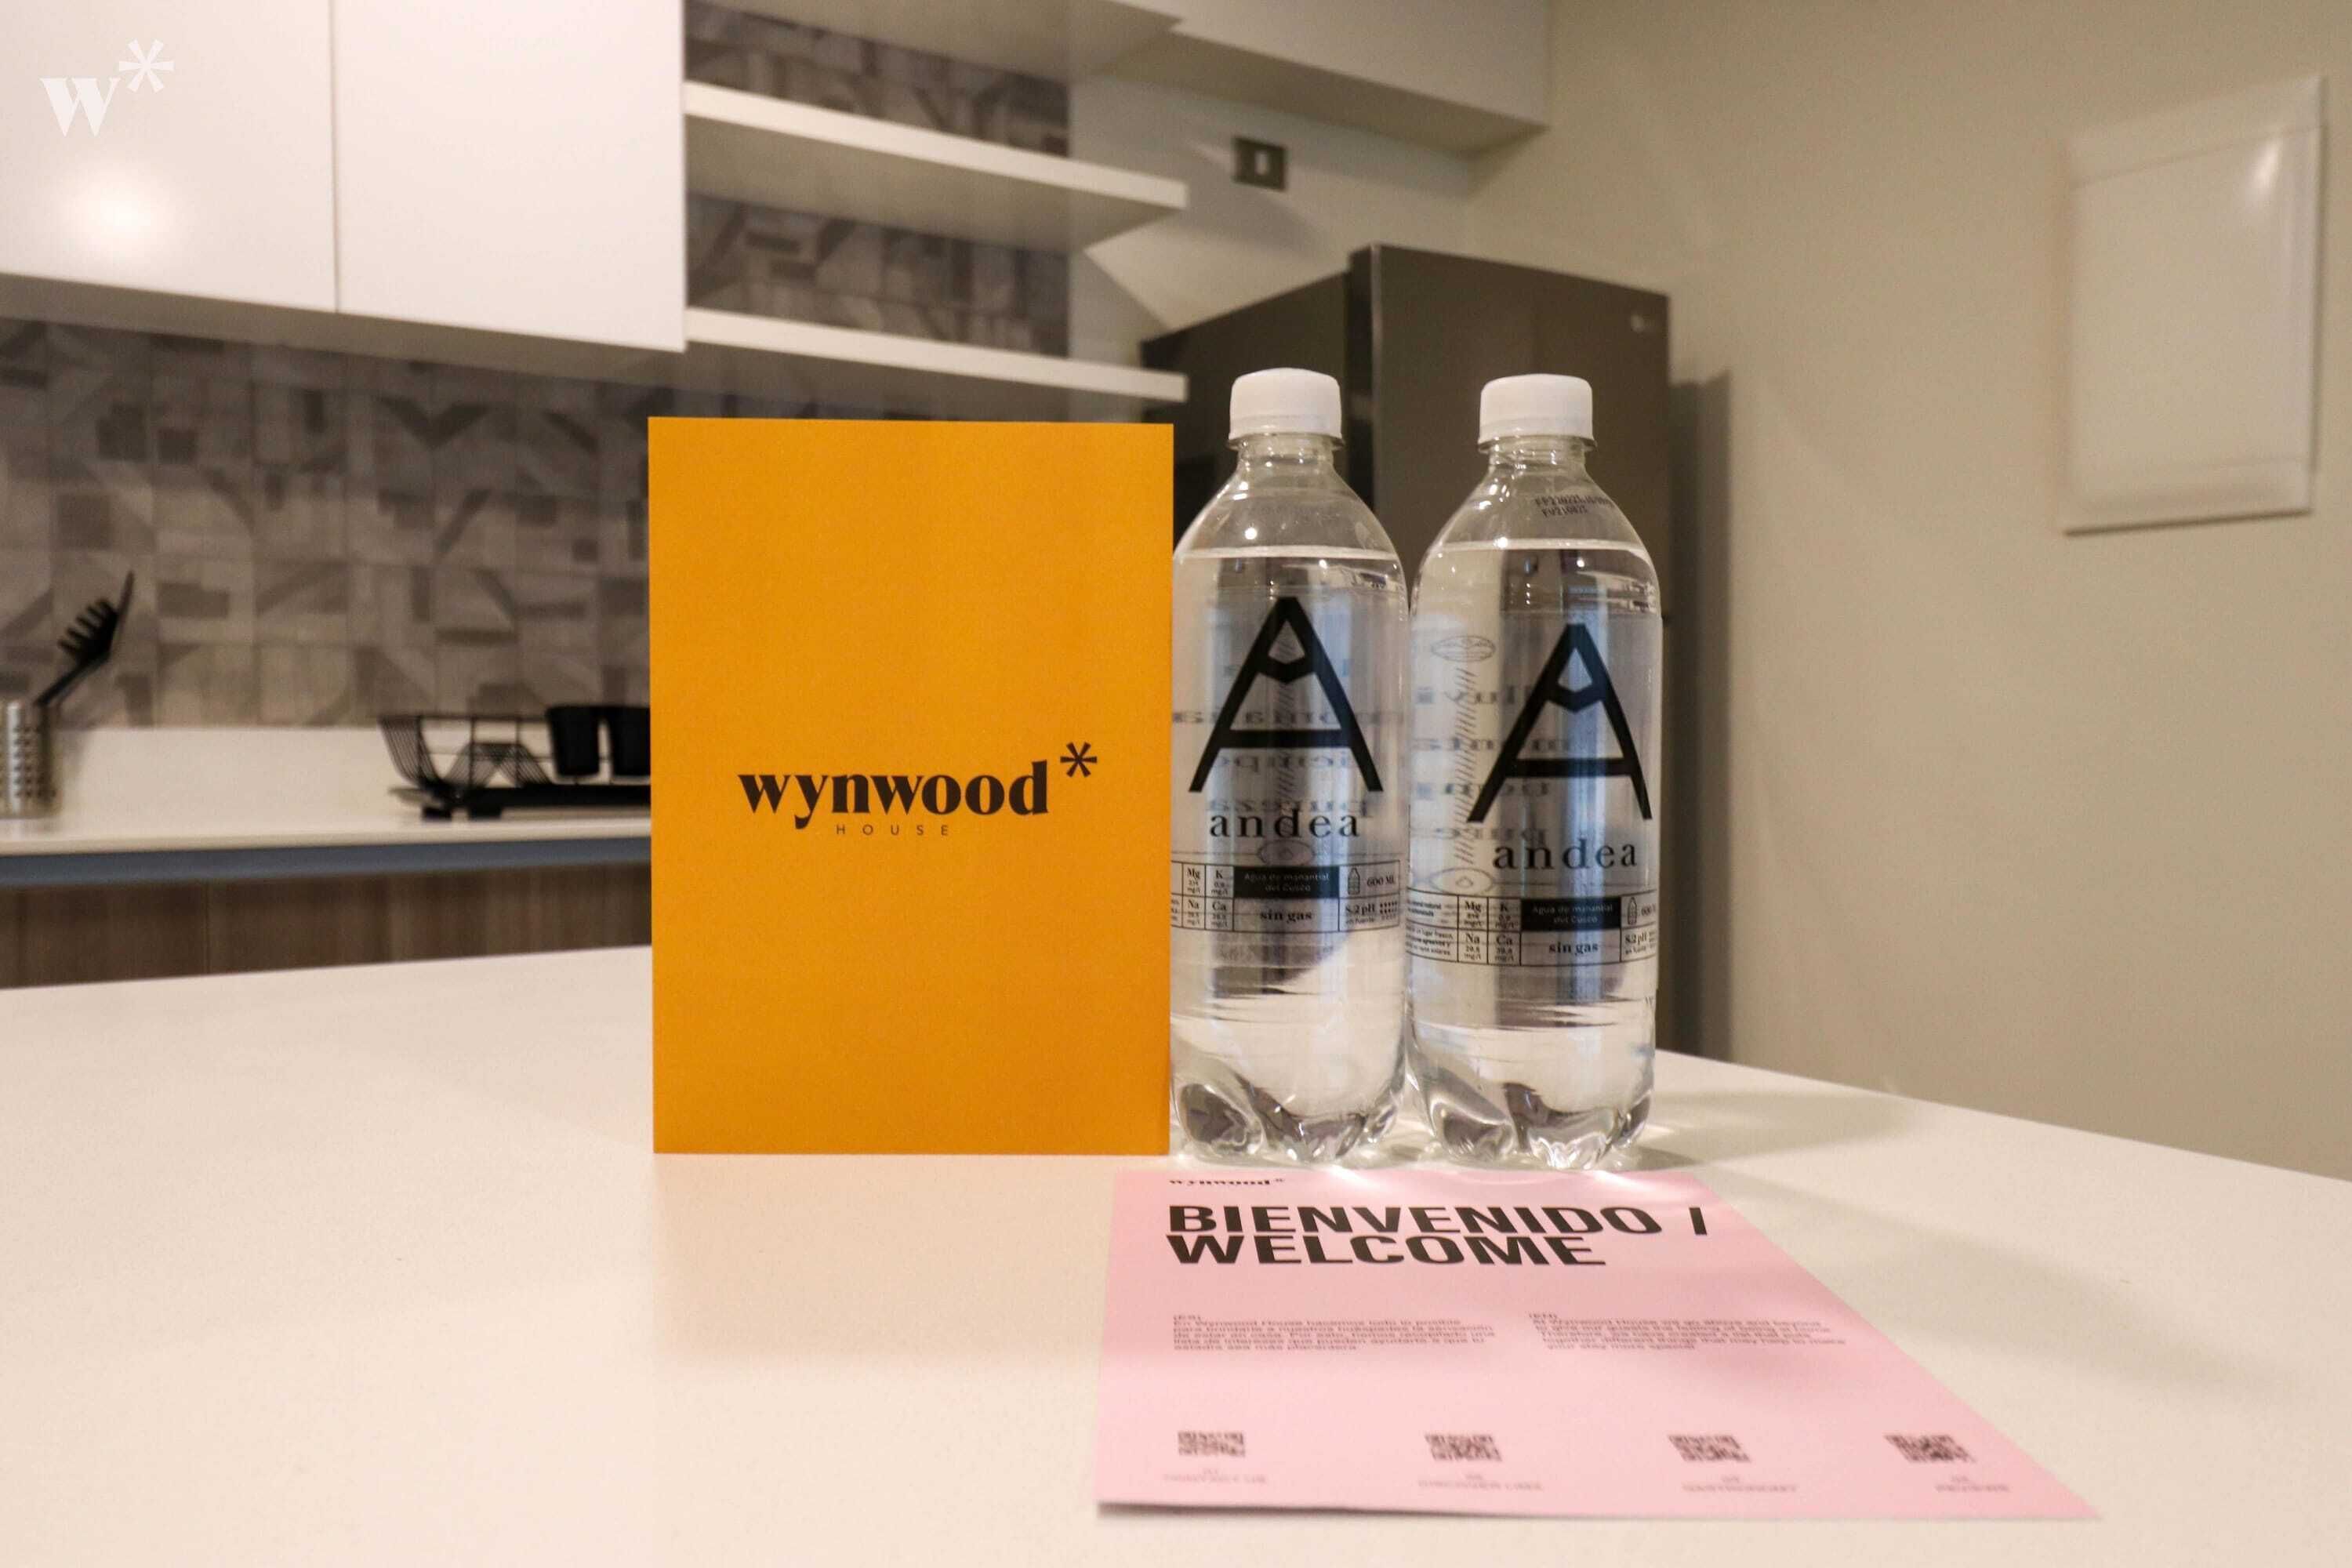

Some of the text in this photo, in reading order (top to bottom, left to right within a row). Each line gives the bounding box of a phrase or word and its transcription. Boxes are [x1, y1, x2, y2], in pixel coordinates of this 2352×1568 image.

[836, 824, 949, 836] HOUSE
[1209, 808, 1359, 838] andea
[1493, 838, 1637, 870] andea
[1214, 869, 1223, 879] K
[1465, 900, 1482, 913] Mg
[1260, 909, 1313, 924] sin gas
[1465, 933, 1480, 945] Na
[1496, 935, 1513, 946] Ca
[1548, 942, 1599, 956] sin gas
[1169, 1206, 1663, 1234] BIENVENIDO
[1167, 1235, 1606, 1265] WELCOME
